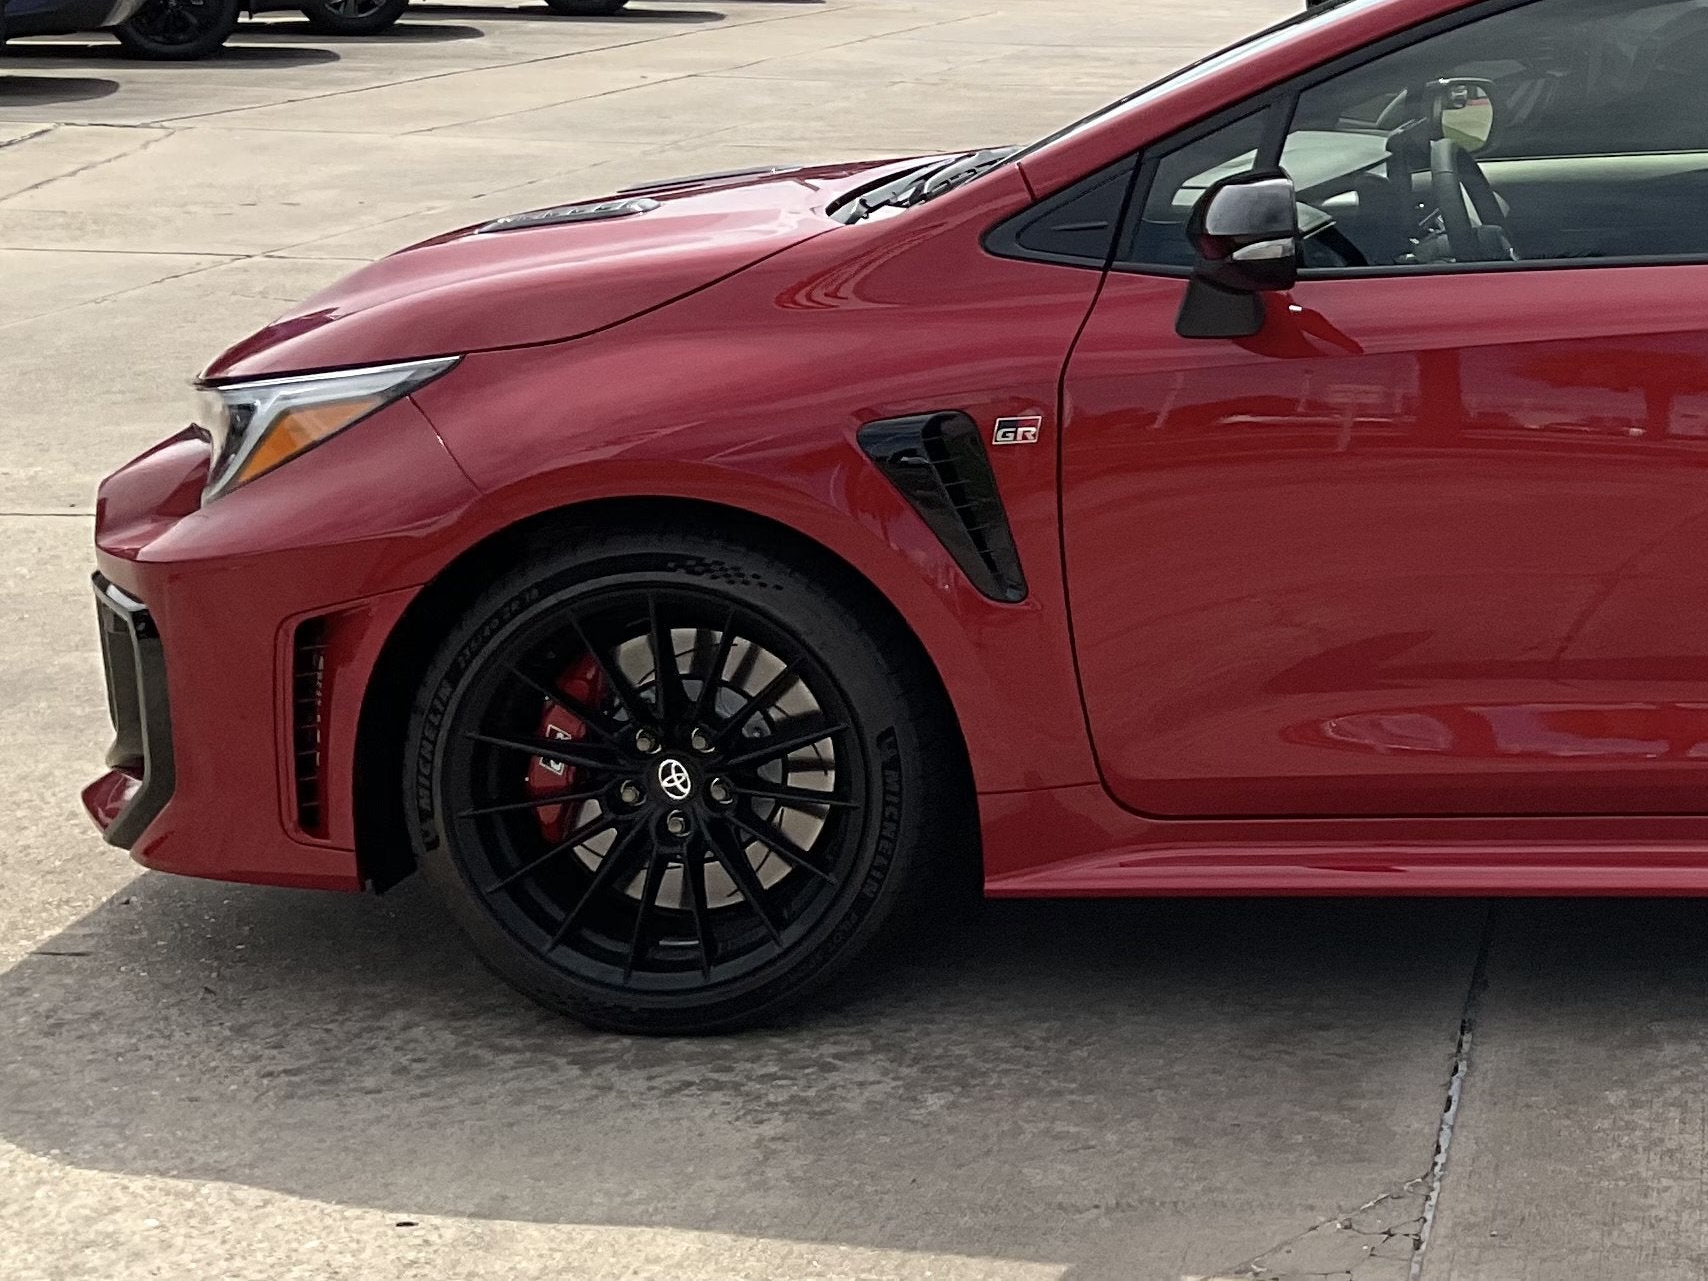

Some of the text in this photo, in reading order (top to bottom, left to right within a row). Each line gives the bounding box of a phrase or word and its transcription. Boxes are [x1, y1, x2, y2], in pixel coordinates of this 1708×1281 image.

[996, 427, 1037, 441] GR
[417, 678, 455, 811] MICHELIN
[861, 769, 900, 898] MICHELIN
